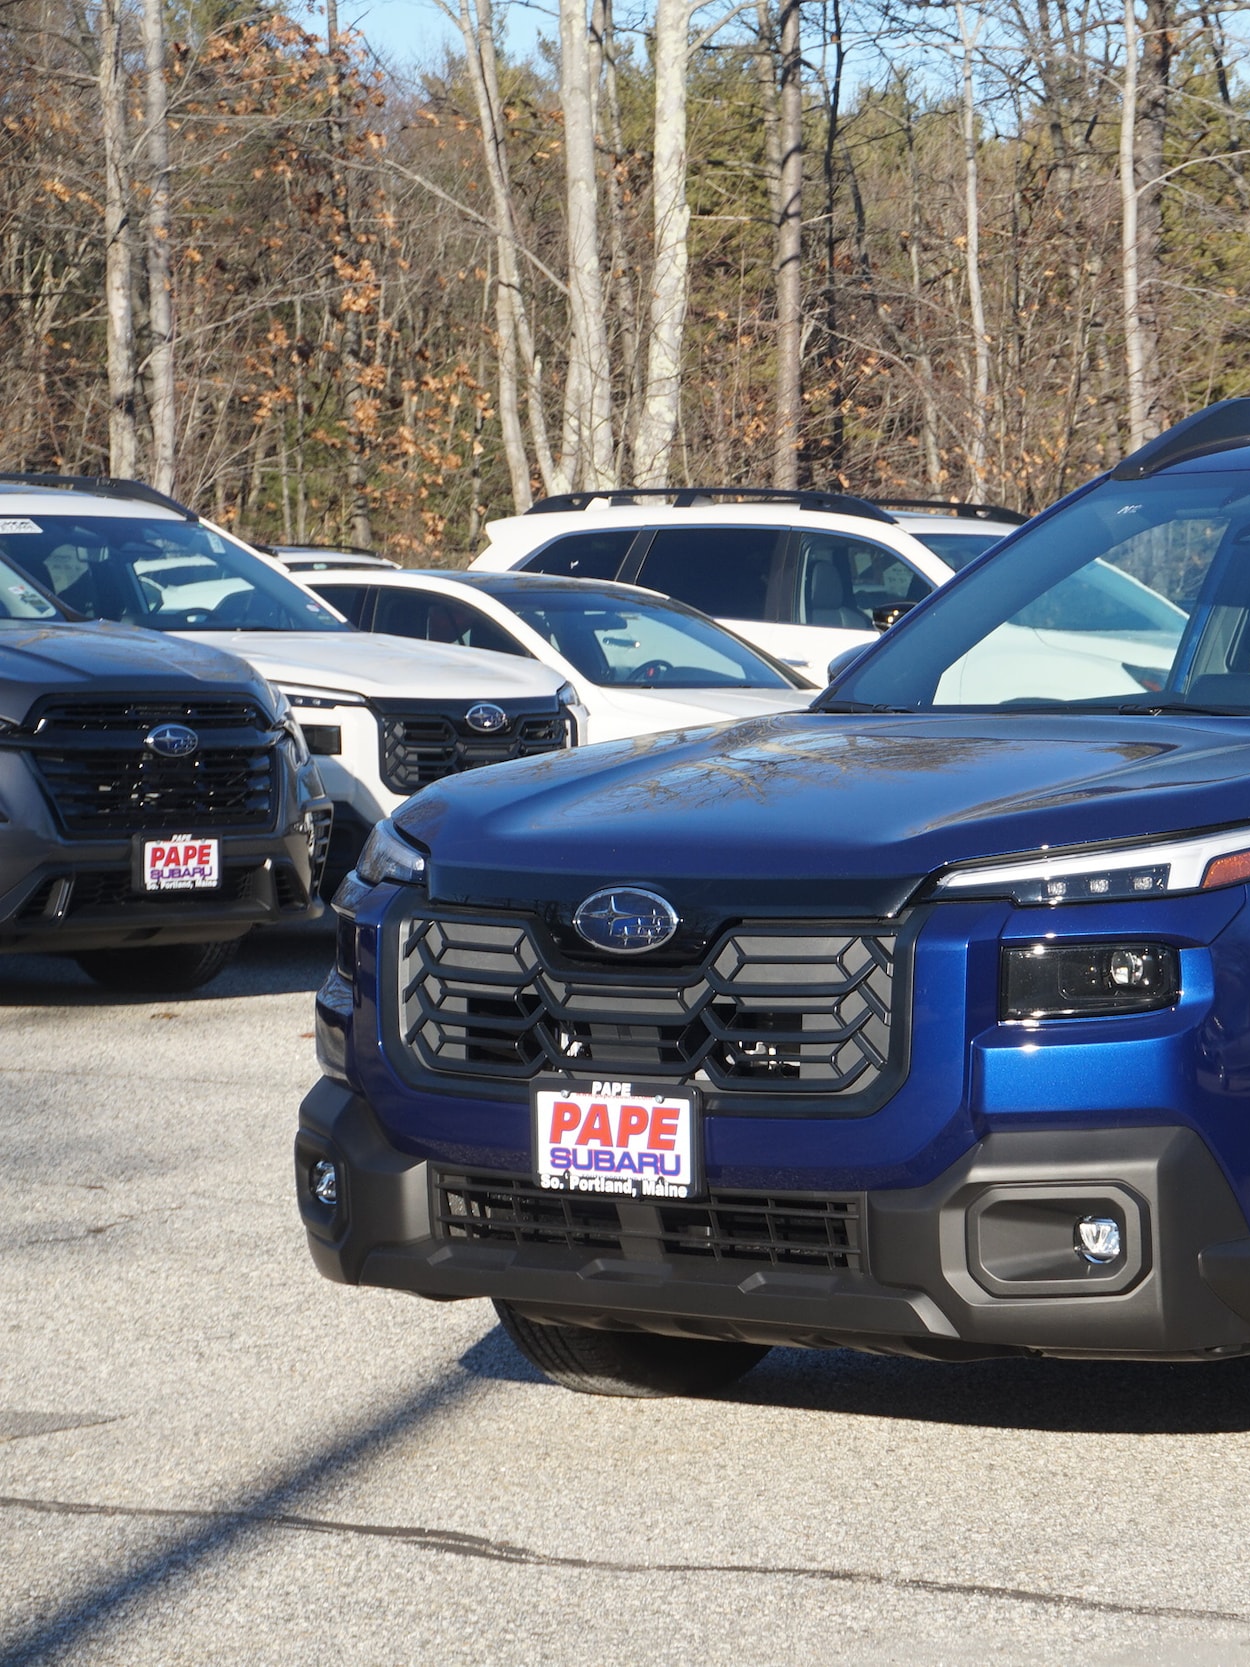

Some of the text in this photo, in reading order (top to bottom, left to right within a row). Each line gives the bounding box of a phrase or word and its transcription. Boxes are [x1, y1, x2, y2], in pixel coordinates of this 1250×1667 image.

[150, 844, 212, 868] PAPE
[150, 866, 213, 880] SUBARU
[591, 1081, 632, 1097] PAPE
[549, 1101, 681, 1151] PAPE
[550, 1147, 681, 1177] SUBARU
[540, 1174, 688, 1199] So. Portland, Maine
